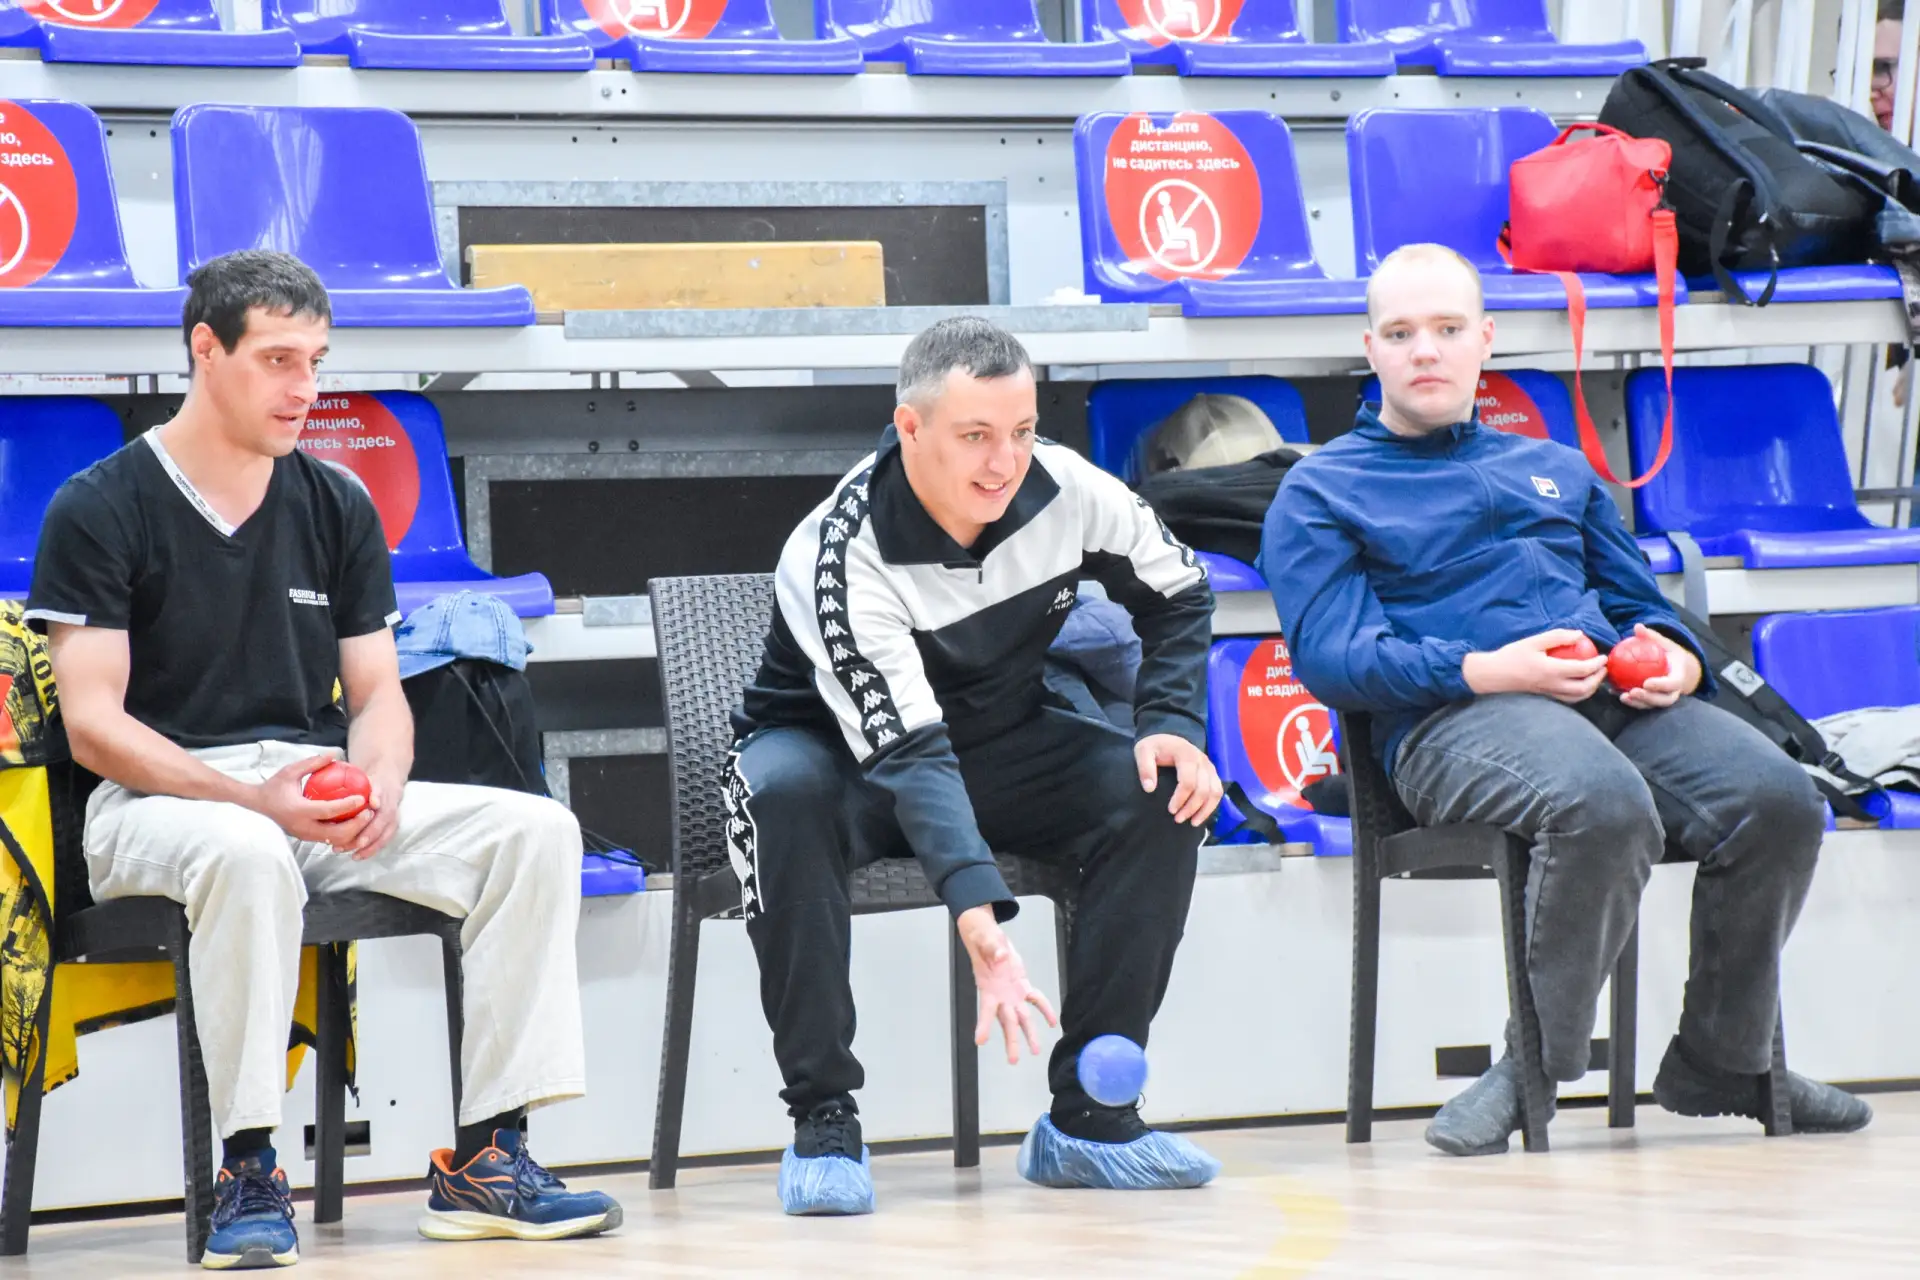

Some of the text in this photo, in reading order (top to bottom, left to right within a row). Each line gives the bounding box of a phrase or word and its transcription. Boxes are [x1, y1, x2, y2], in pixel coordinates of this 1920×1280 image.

[1138, 118, 1200, 136] Дите
[1130, 139, 1213, 154] дистанцию,
[1, 152, 55, 168] здесь
[1112, 157, 1241, 172] не садитесь здесь
[310, 398, 350, 411] жите
[306, 416, 366, 431] анцию,
[1485, 412, 1529, 427] здесь
[296, 435, 397, 451] итесь здесь
[289, 588, 317, 601] FASHION
[1247, 683, 1306, 698] не садит
